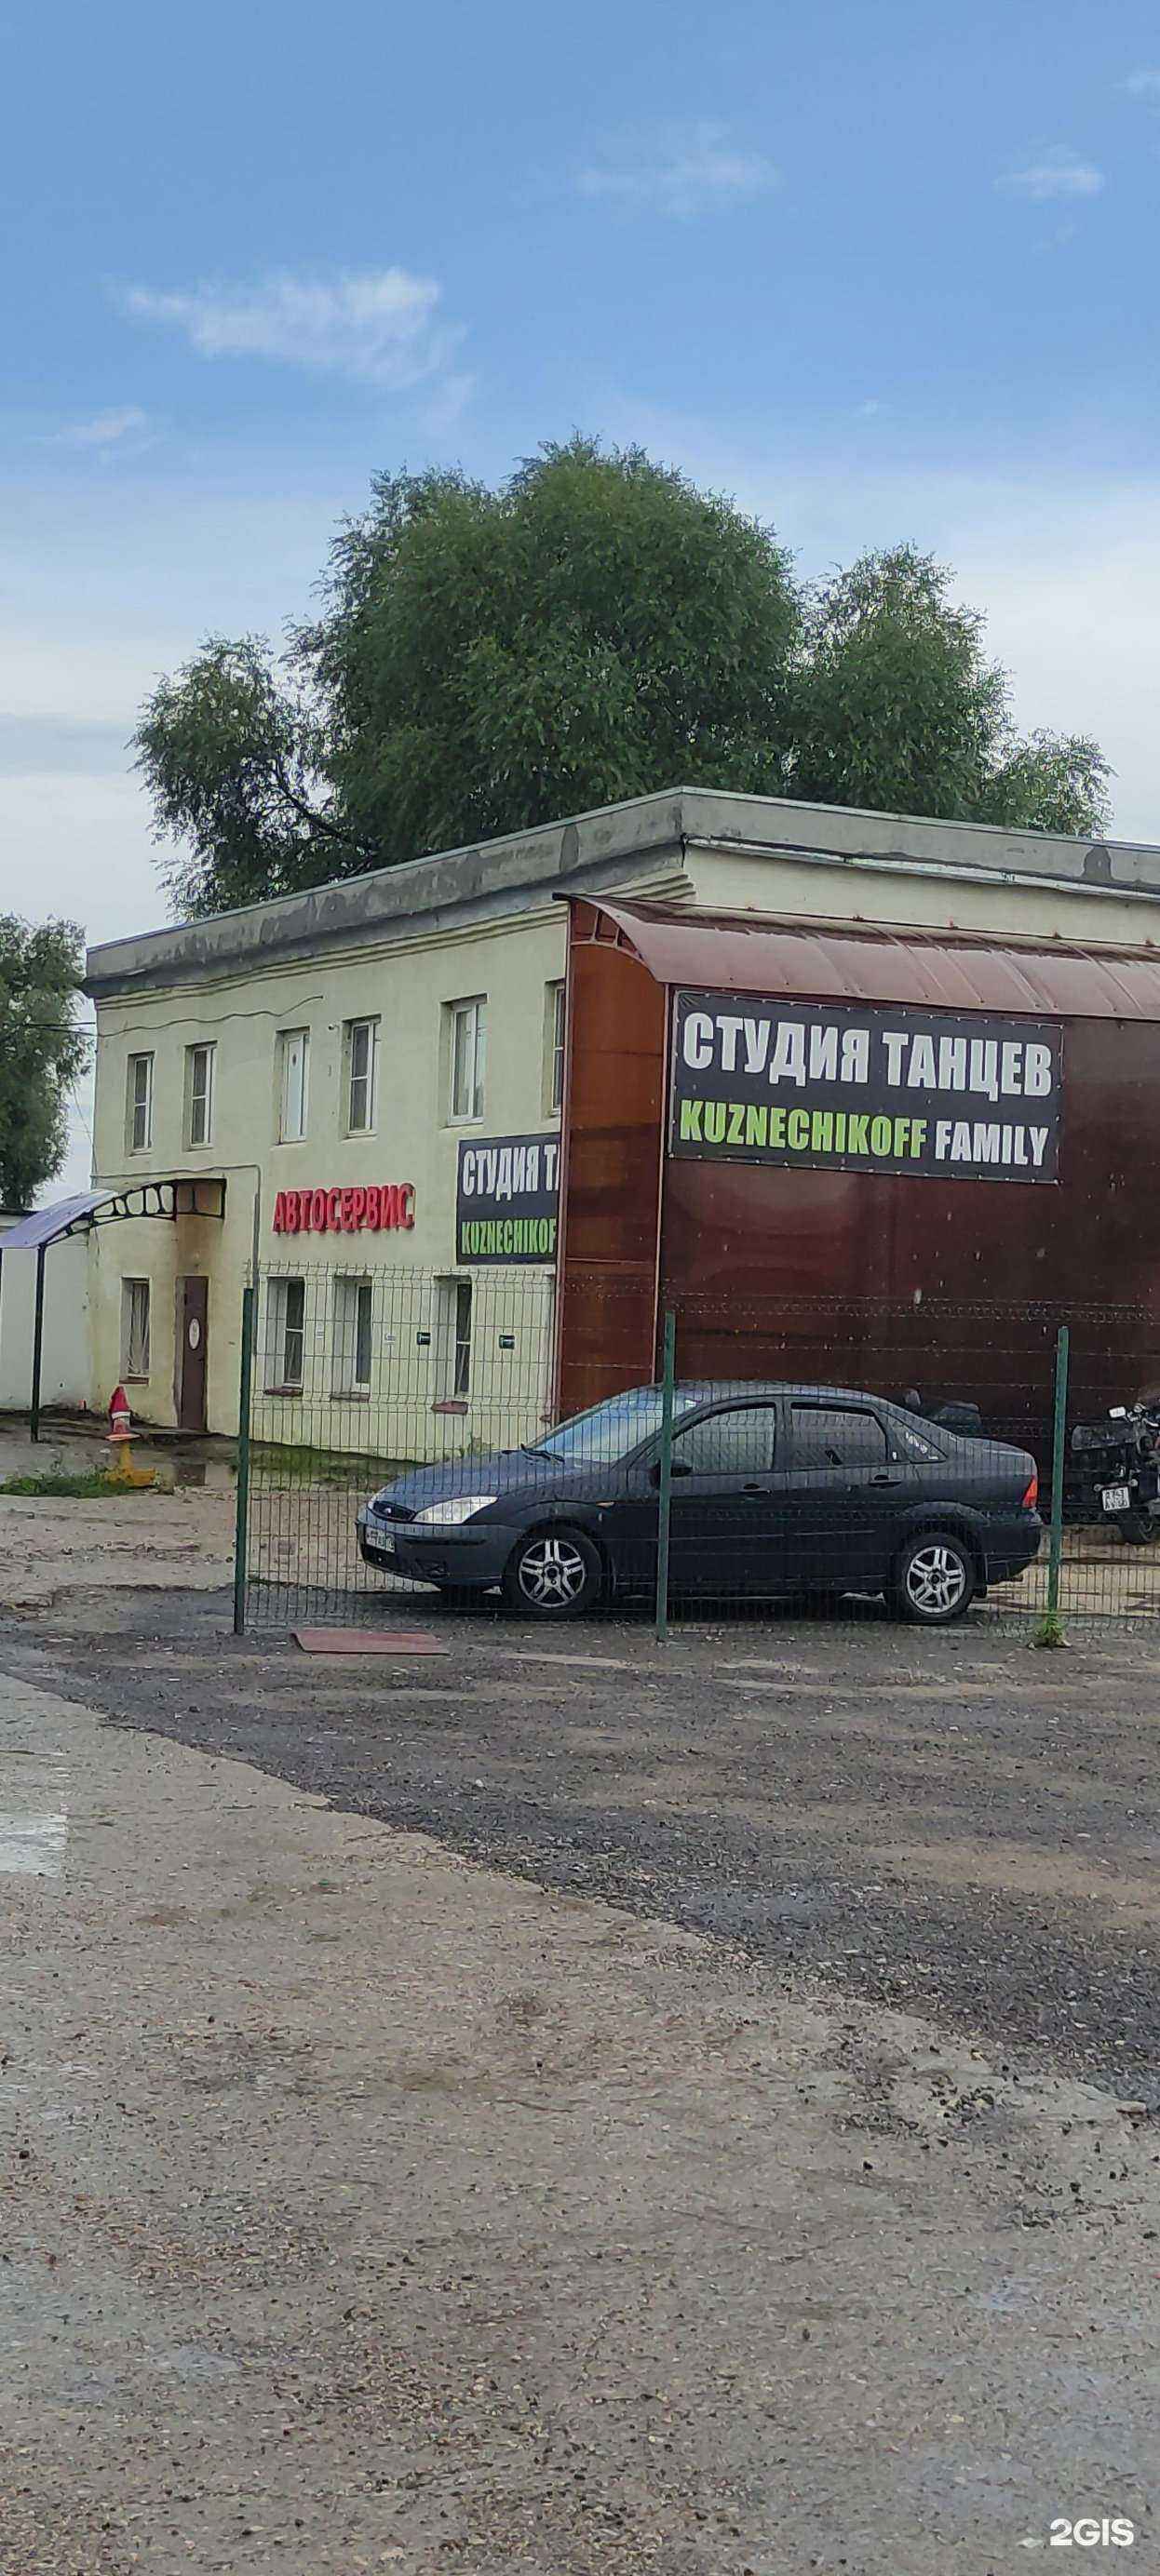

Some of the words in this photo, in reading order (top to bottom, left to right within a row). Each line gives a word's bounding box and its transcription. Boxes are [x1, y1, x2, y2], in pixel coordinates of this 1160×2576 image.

[682, 1012, 870, 1088] СТУДИЯ
[882, 1030, 1053, 1102] ТАНЦЕВ
[679, 1099, 927, 1159] KUZNECHIKOFF
[934, 1120, 1049, 1167] FAMILY
[463, 1145, 540, 1201] СТУДИЯ
[272, 1182, 415, 1234] АВТОСЕРВИС
